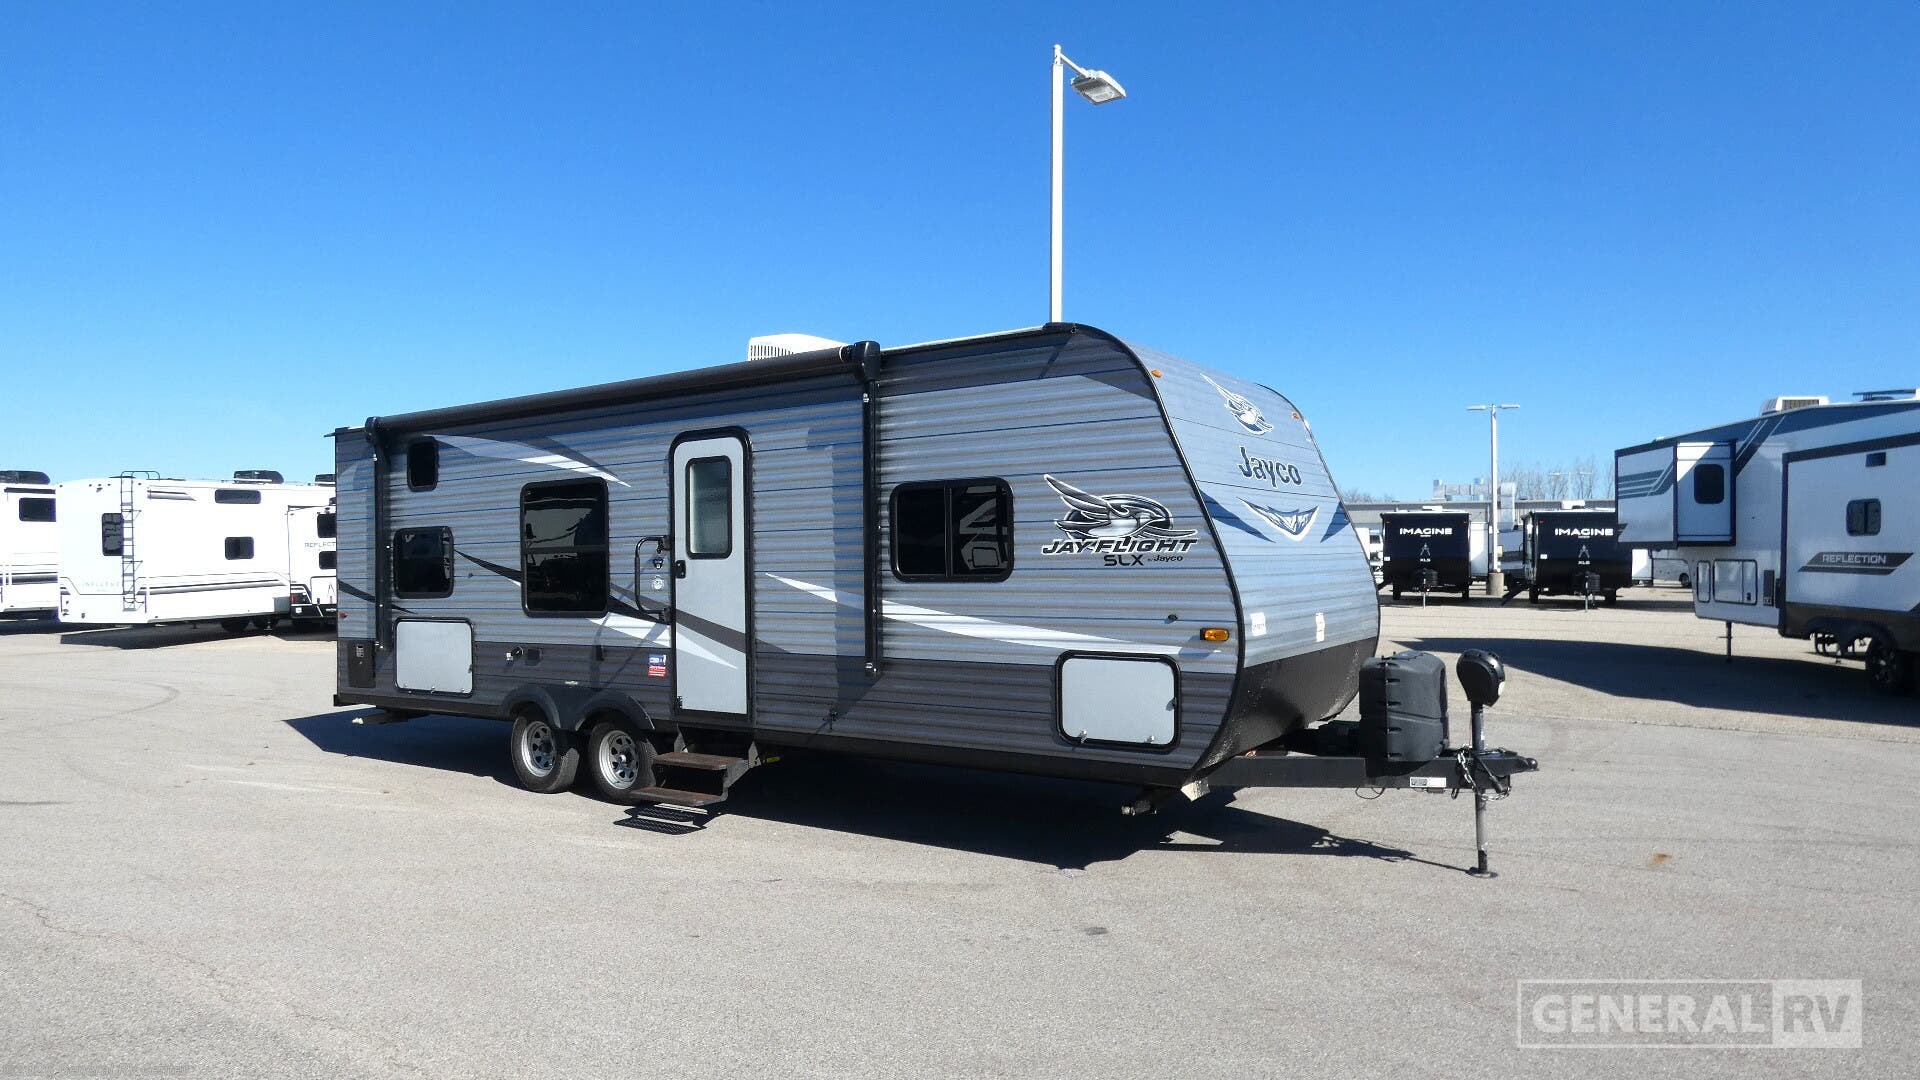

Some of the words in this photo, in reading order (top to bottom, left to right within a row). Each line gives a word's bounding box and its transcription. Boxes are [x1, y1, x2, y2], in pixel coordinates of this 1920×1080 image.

[1238, 445, 1303, 488] Jayco
[1399, 527, 1453, 535] IMAGINE
[1554, 528, 1614, 536] IMAGINE
[1103, 554, 1145, 567] SLX
[1153, 554, 1184, 563] Jayco
[1822, 554, 1887, 564] REFLECTION
